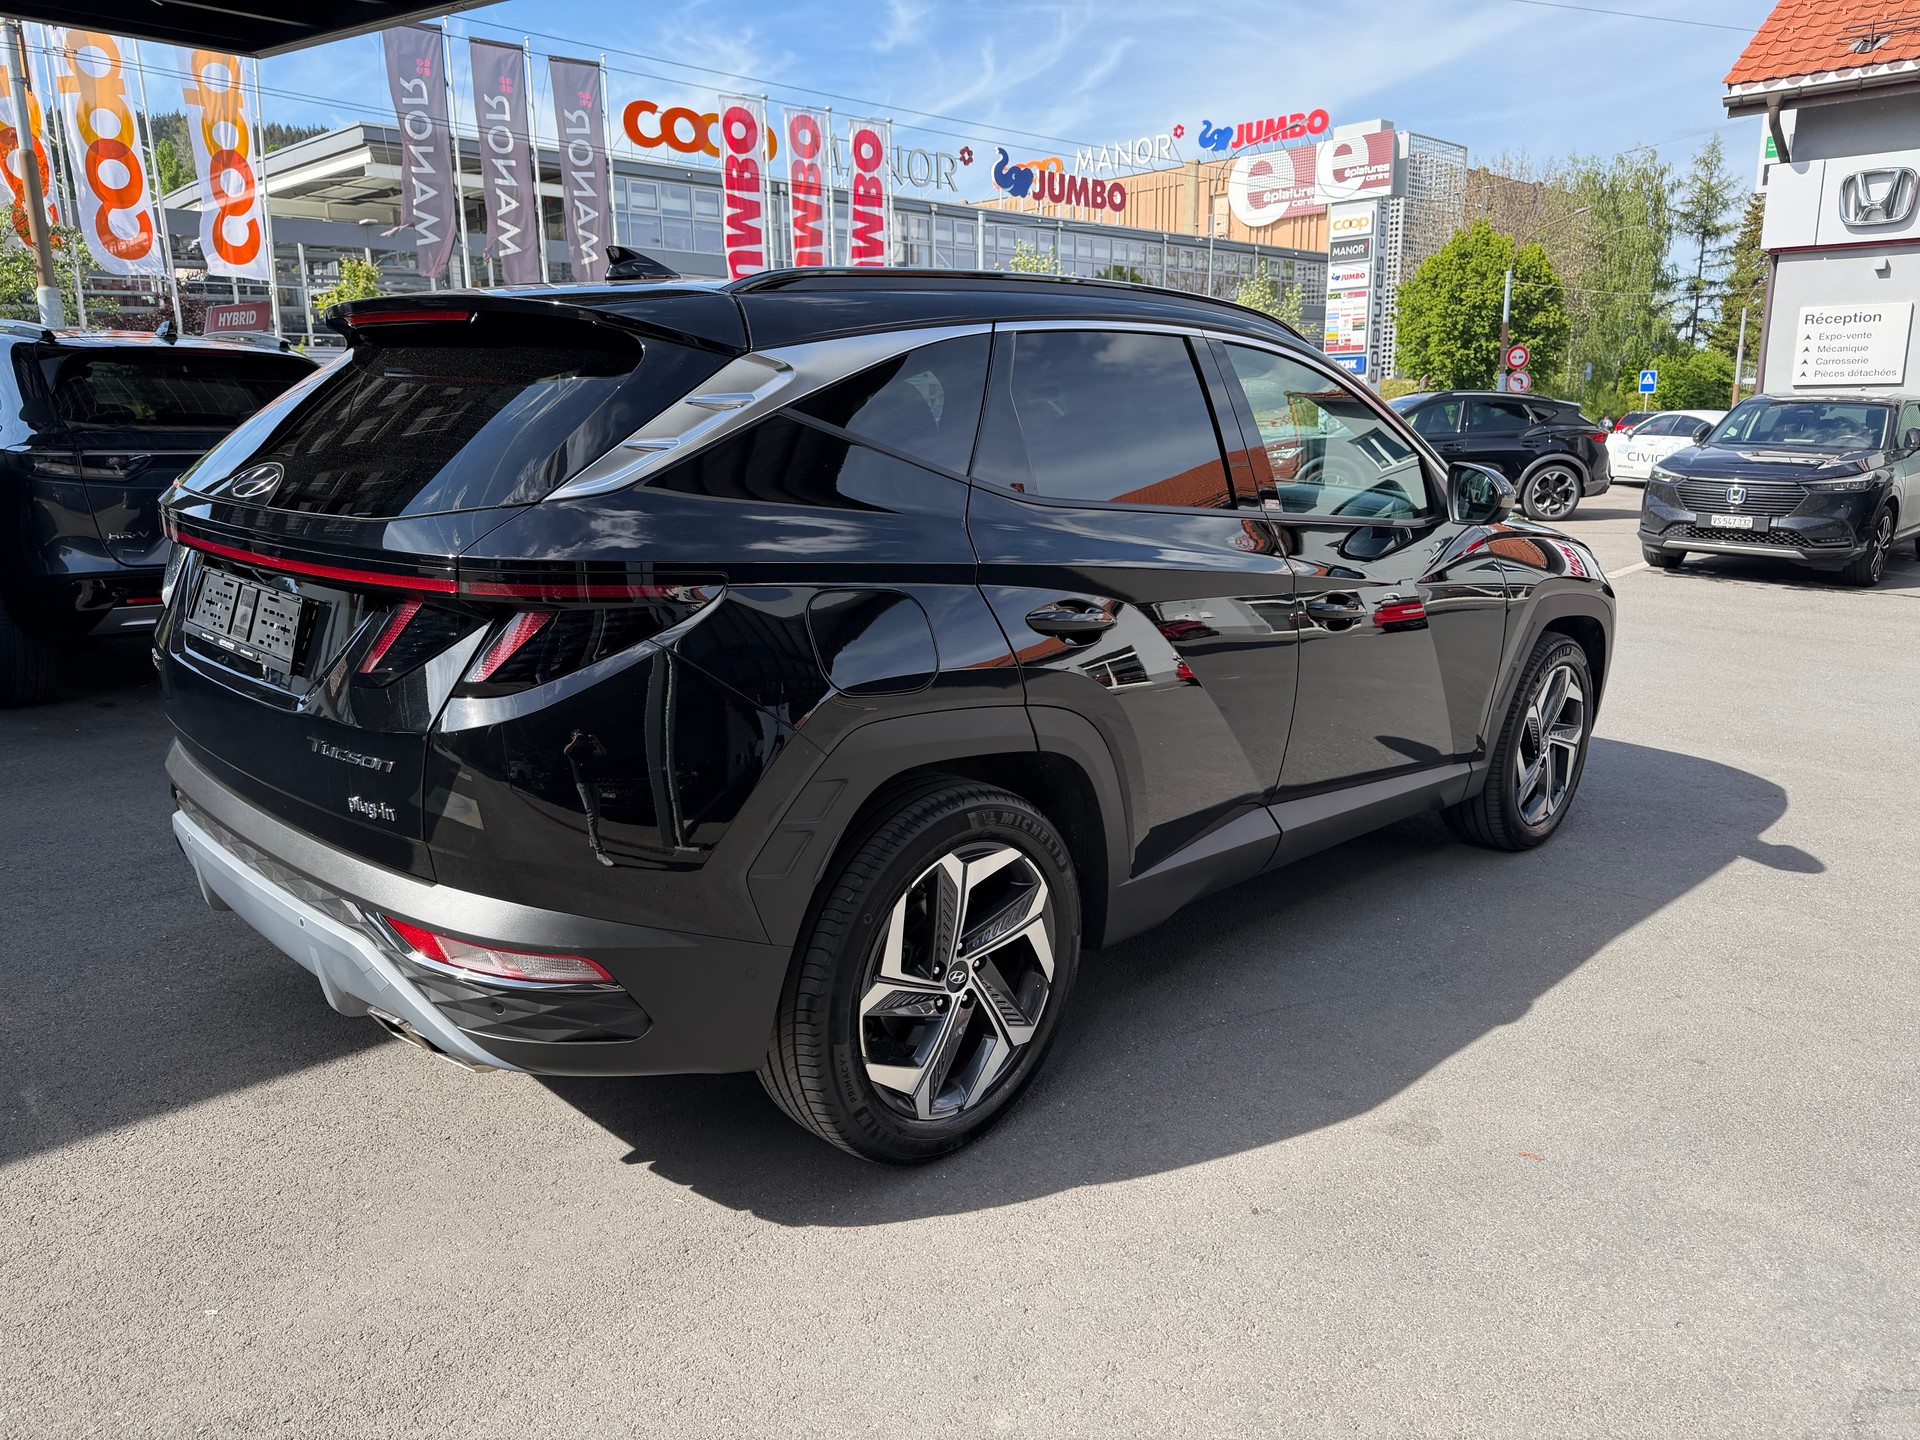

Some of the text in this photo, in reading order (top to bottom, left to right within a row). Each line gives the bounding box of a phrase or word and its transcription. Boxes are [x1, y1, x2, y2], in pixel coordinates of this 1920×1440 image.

[1231, 109, 1329, 149] JUMBO
[1075, 134, 1171, 175] MANOR
[1032, 170, 1126, 212] JUMBO
[1263, 186, 1315, 203] éplature
[1333, 217, 1369, 231] coop
[1332, 245, 1364, 257] MANOR
[1341, 273, 1366, 281] JUMBO
[218, 310, 257, 327] HYBRID
[1804, 312, 1882, 326] Réception
[1818, 332, 1872, 341] Expo-vente
[1816, 344, 1869, 353] Mécanique
[1336, 359, 1357, 369] YSK
[1815, 356, 1869, 365] Carrosserie
[1813, 368, 1897, 378] Pièces détachées
[108, 530, 150, 540] HR-V
[1000, 812, 1067, 868] MICHELIN
